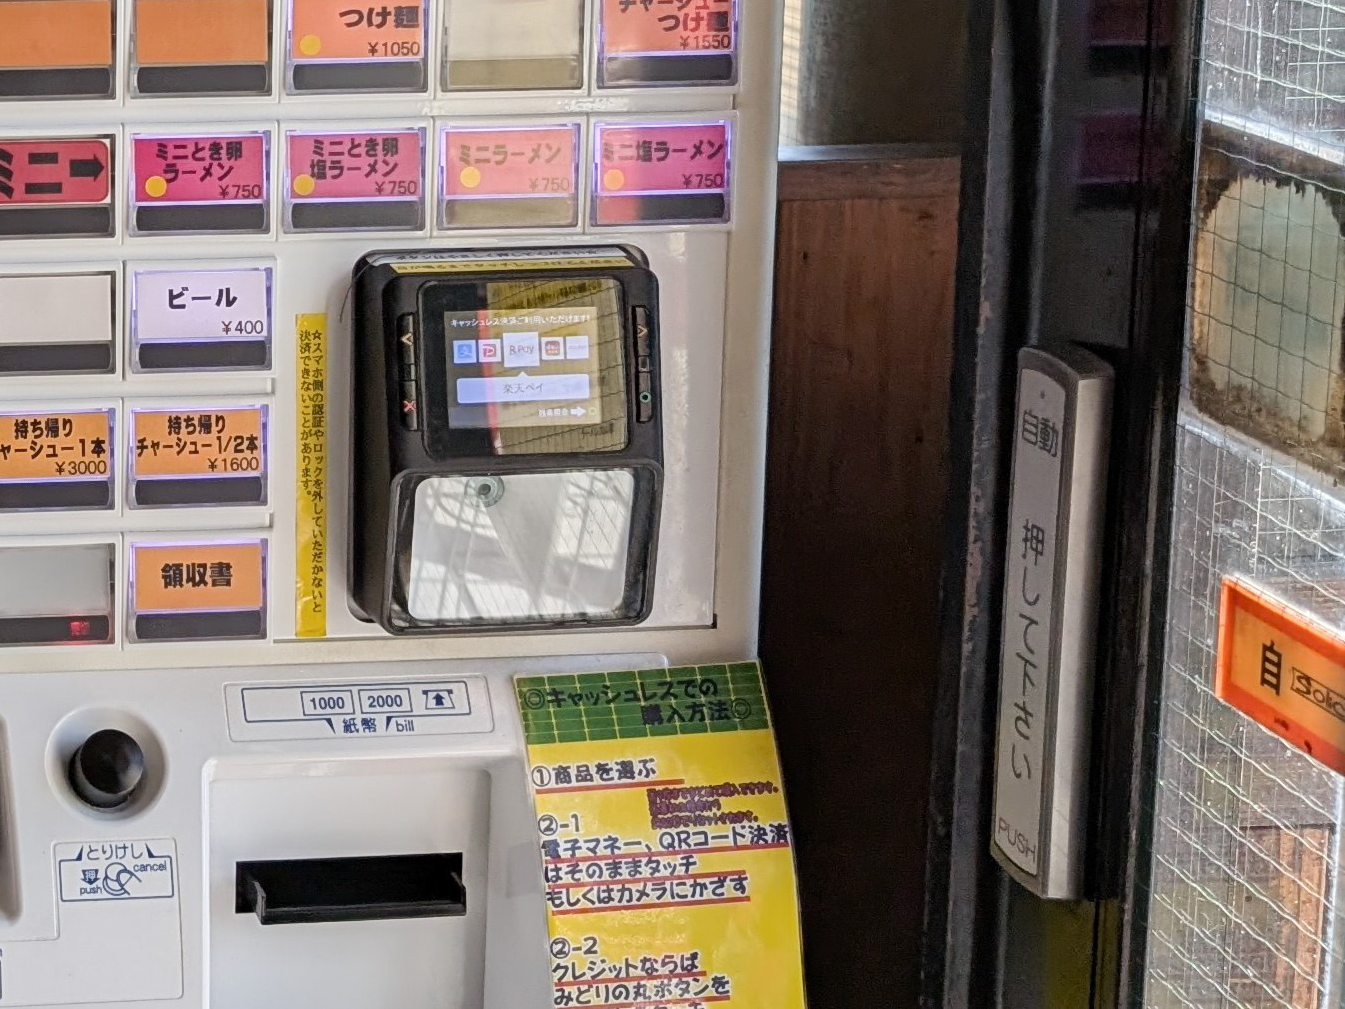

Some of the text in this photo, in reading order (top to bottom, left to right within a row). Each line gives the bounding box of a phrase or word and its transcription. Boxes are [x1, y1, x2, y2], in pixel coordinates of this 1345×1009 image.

[339, 5, 419, 29] つけ麺
[368, 40, 420, 56] ¥1050
[155, 142, 242, 162] ミニとき卵
[311, 138, 398, 159] ミニとき卵
[162, 161, 234, 183] ラーメン
[309, 158, 397, 180] 塩ラーメン
[218, 183, 262, 200] ¥750
[168, 288, 238, 310] ビール
[221, 320, 263, 335] ¥400
[14, 418, 73, 439] 持ち帰り
[168, 415, 226, 435] 持ち帰り
[55, 460, 107, 475] ¥3000
[207, 456, 259, 472] ¥1600
[161, 561, 233, 589] 領収書
[309, 694, 403, 710] 1000 2000
[342, 718, 414, 733] 紙幣 bill
[998, 817, 1036, 863] PUSH
[87, 843, 143, 860] とりけし
[133, 860, 167, 872] cancel
[544, 856, 697, 881] はそのままタッチ
[552, 952, 699, 982] クレジットならば
